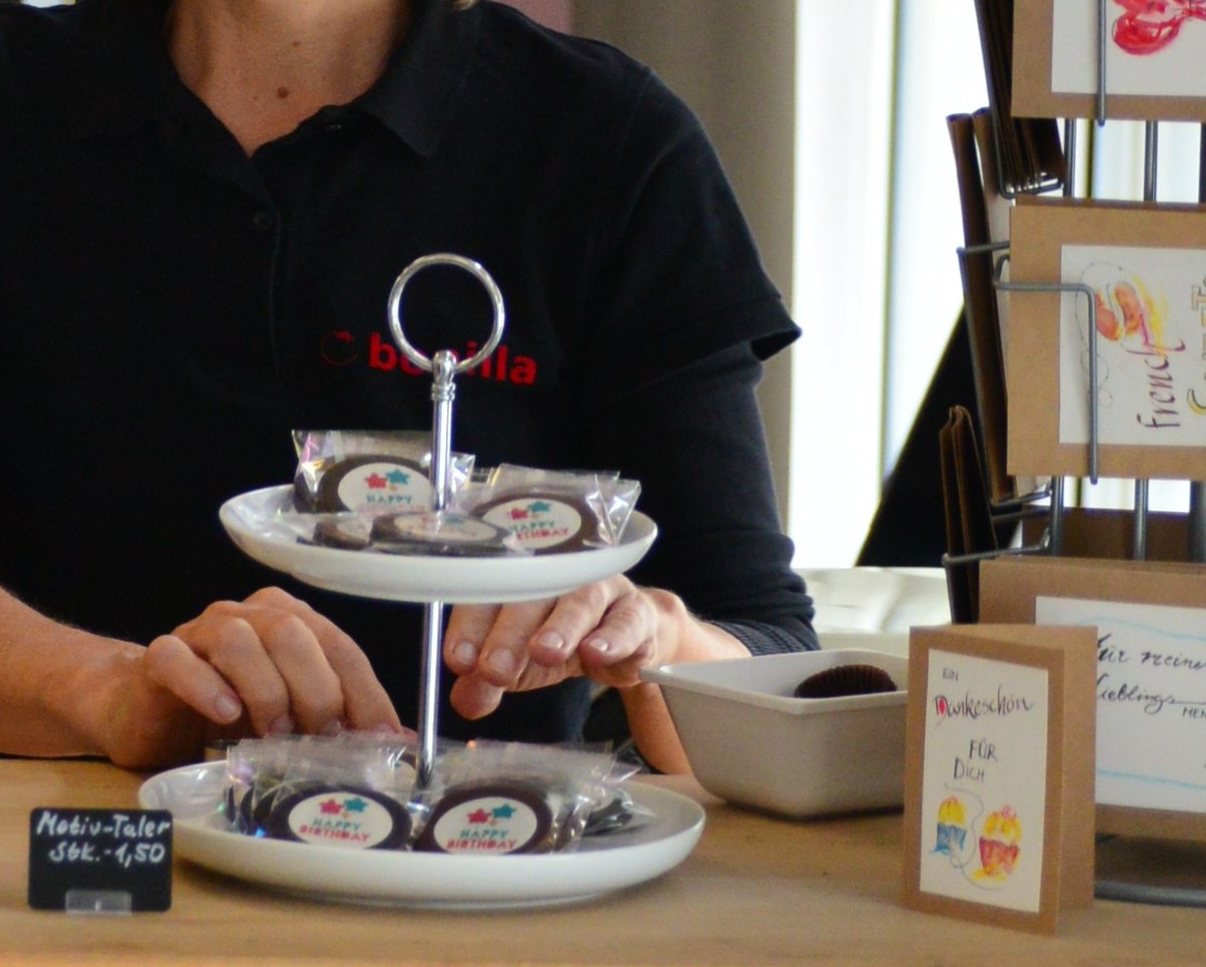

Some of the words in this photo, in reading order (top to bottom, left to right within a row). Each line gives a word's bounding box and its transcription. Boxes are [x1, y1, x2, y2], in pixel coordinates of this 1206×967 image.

[368, 333, 538, 386] boilla
[366, 494, 413, 504] HAPPY
[1141, 650, 1206, 670] meine
[941, 667, 959, 682] EIN
[36, 811, 171, 839] Motiv-Taler
[313, 817, 362, 832] HAPPY
[298, 824, 371, 843] BIRTHDAY
[459, 828, 510, 839] HAPPY
[446, 838, 518, 850] BIRTHDAY
